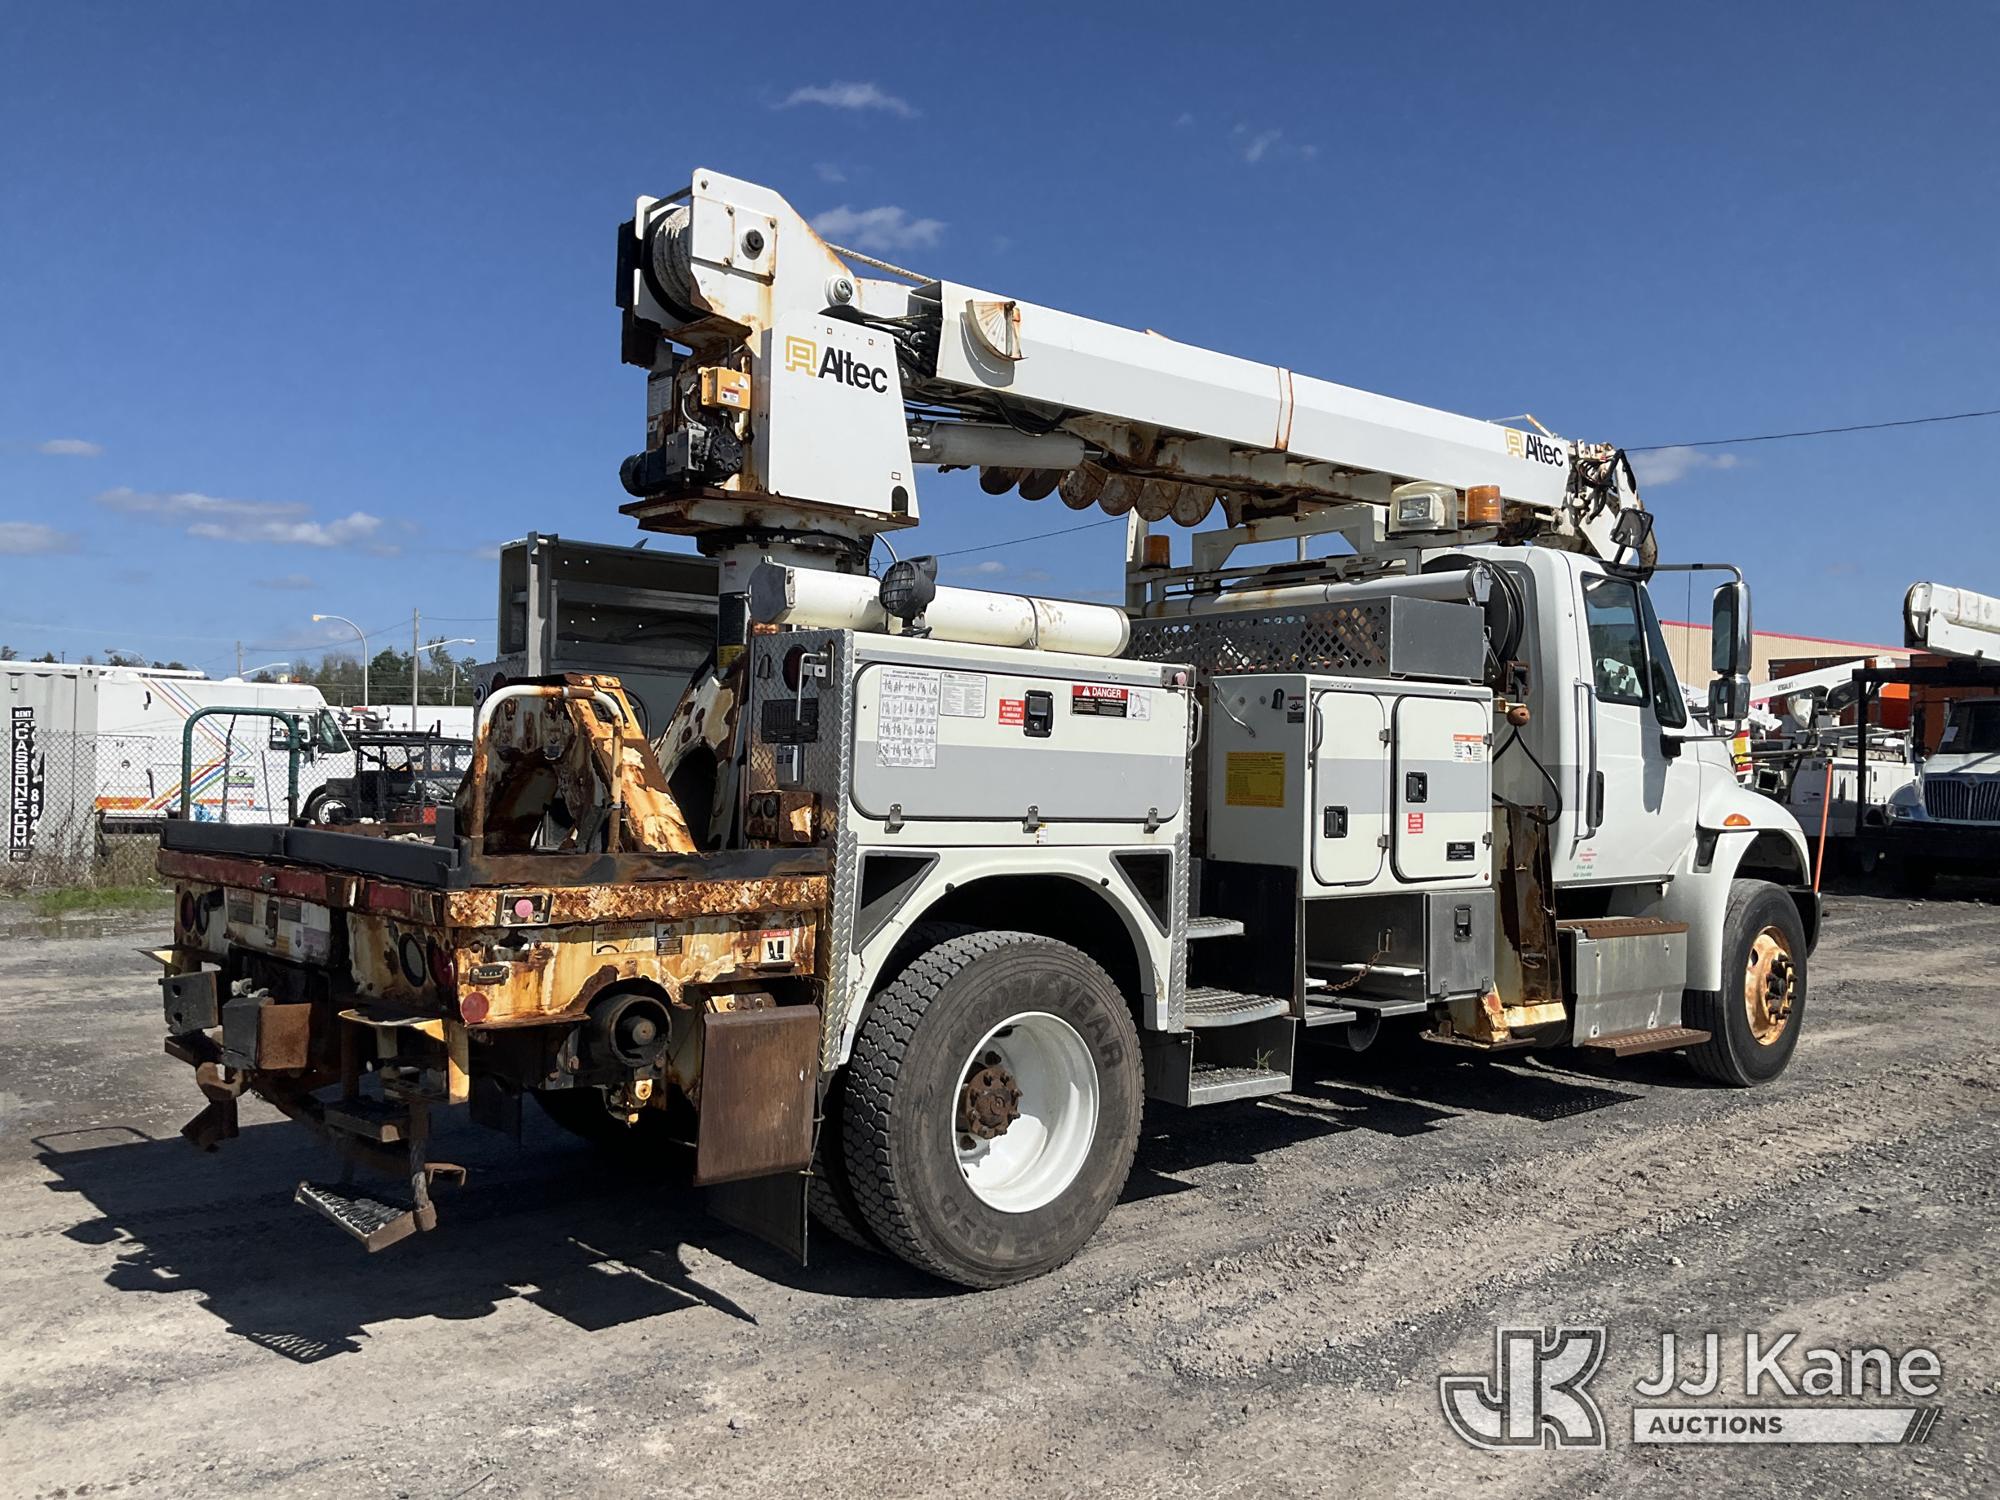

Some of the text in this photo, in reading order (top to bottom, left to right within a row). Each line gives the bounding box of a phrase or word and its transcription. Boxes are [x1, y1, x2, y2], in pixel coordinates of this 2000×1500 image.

[818, 346, 888, 394] Altec
[1526, 434, 1563, 467] Altec
[1091, 687, 1121, 698] DANGER
[14, 710, 32, 718] RENT
[14, 728, 29, 848] CASSONE.COM
